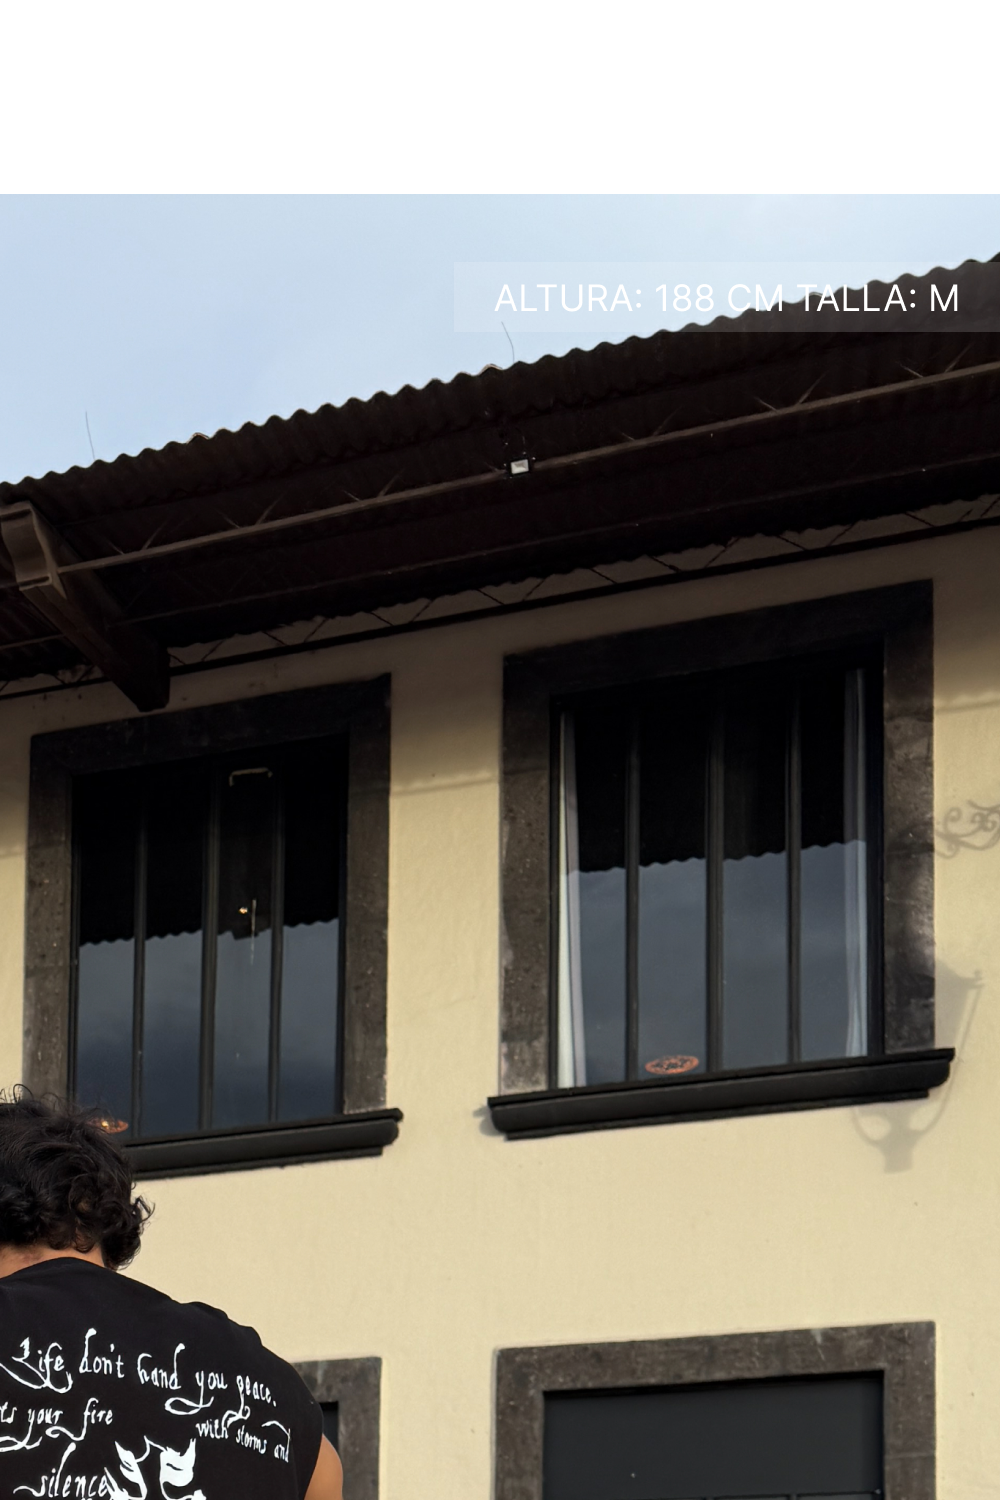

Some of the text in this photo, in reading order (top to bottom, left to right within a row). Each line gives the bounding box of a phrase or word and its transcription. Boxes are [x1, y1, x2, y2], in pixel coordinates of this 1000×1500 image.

[79, 1327, 125, 1378] don't
[137, 1342, 187, 1390] hand
[165, 1370, 228, 1415] you
[45, 1397, 114, 1441] fire
[195, 1410, 231, 1440] with
[235, 1424, 268, 1455] storms
